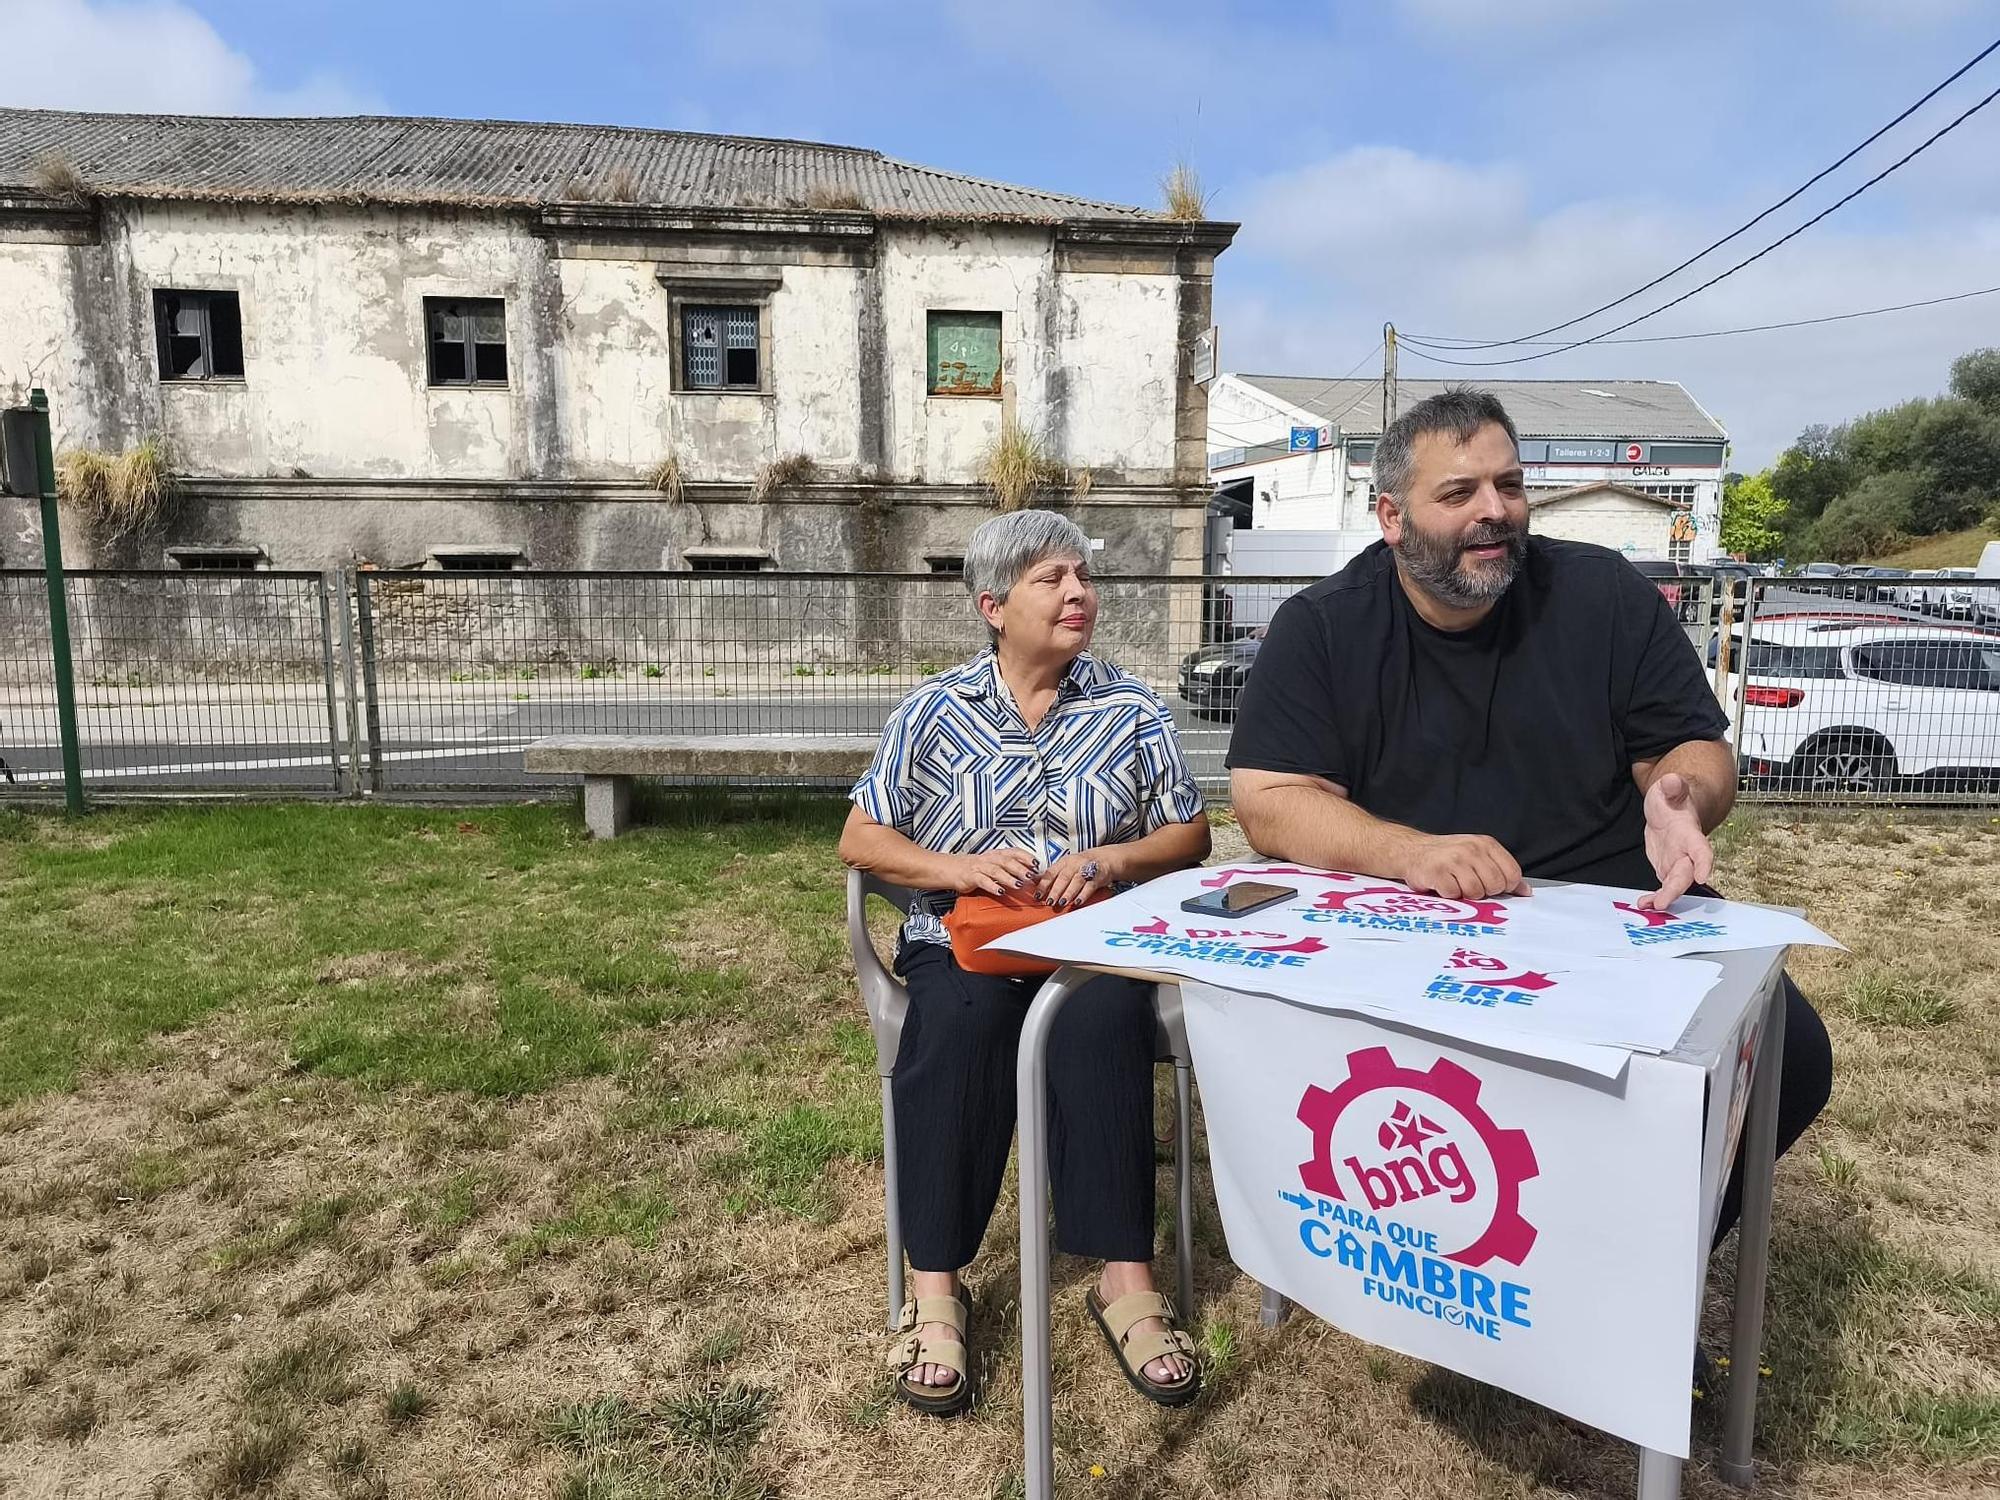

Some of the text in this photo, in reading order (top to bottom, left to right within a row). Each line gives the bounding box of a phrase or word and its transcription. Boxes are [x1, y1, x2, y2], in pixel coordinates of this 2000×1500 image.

[1324, 909, 1381, 917] PARA
[1354, 902, 1461, 914] bng
[1302, 913, 1507, 936] CAMBRE
[1104, 937, 1312, 967] CAMBRE
[1136, 933, 1243, 948] PARA QUE
[1151, 949, 1276, 970] FUNCIONE
[1426, 981, 1540, 1006] BRE
[1343, 1141, 1477, 1211] bng
[1317, 1198, 1439, 1254] PARA QUE
[1299, 1218, 1532, 1328] CAMBRE
[1362, 1276, 1502, 1341] FUNCIONE
